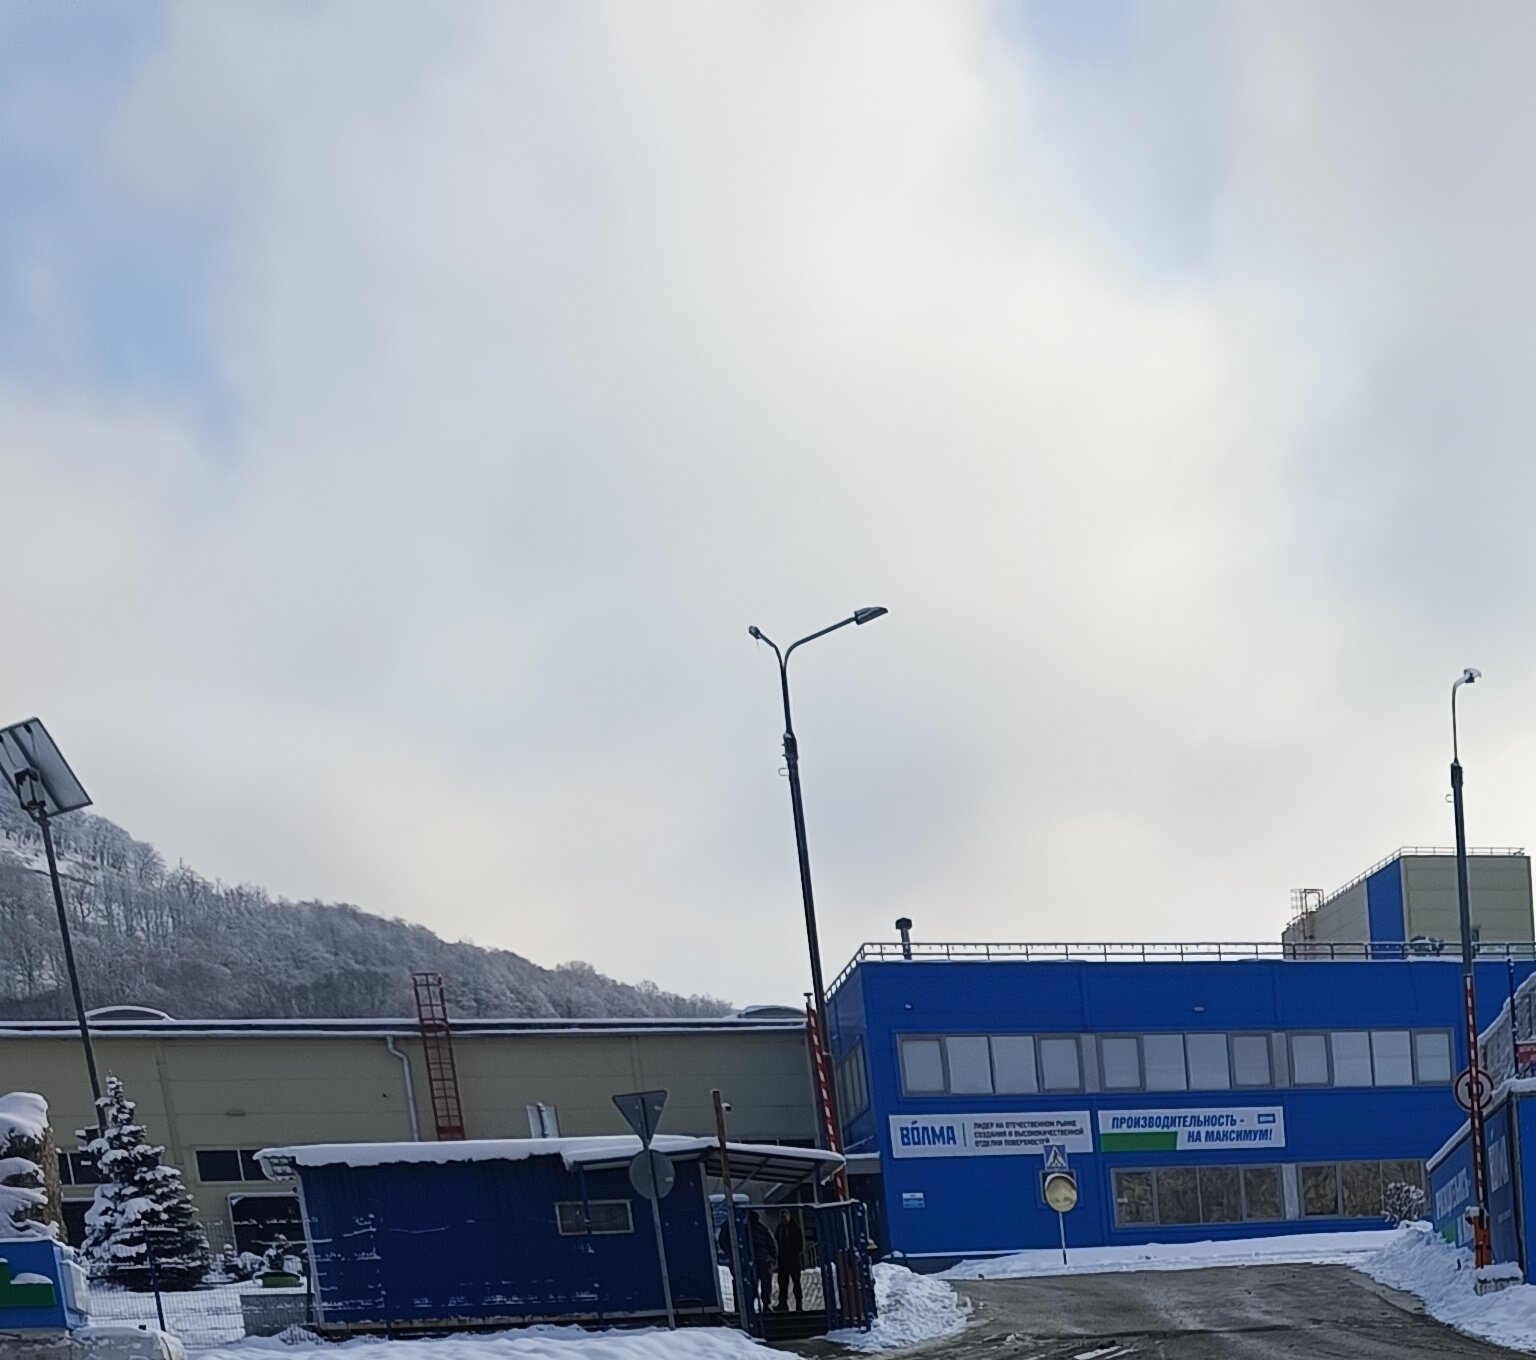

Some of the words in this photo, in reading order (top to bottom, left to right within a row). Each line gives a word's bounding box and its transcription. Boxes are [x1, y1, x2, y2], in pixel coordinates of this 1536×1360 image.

[1111, 1114, 1237, 1130] ПРОИЗВОДИТЕЛЬНОСТЬ
[1187, 1130, 1202, 1143] НА
[1204, 1129, 1273, 1143] МАКСИМУМ!
